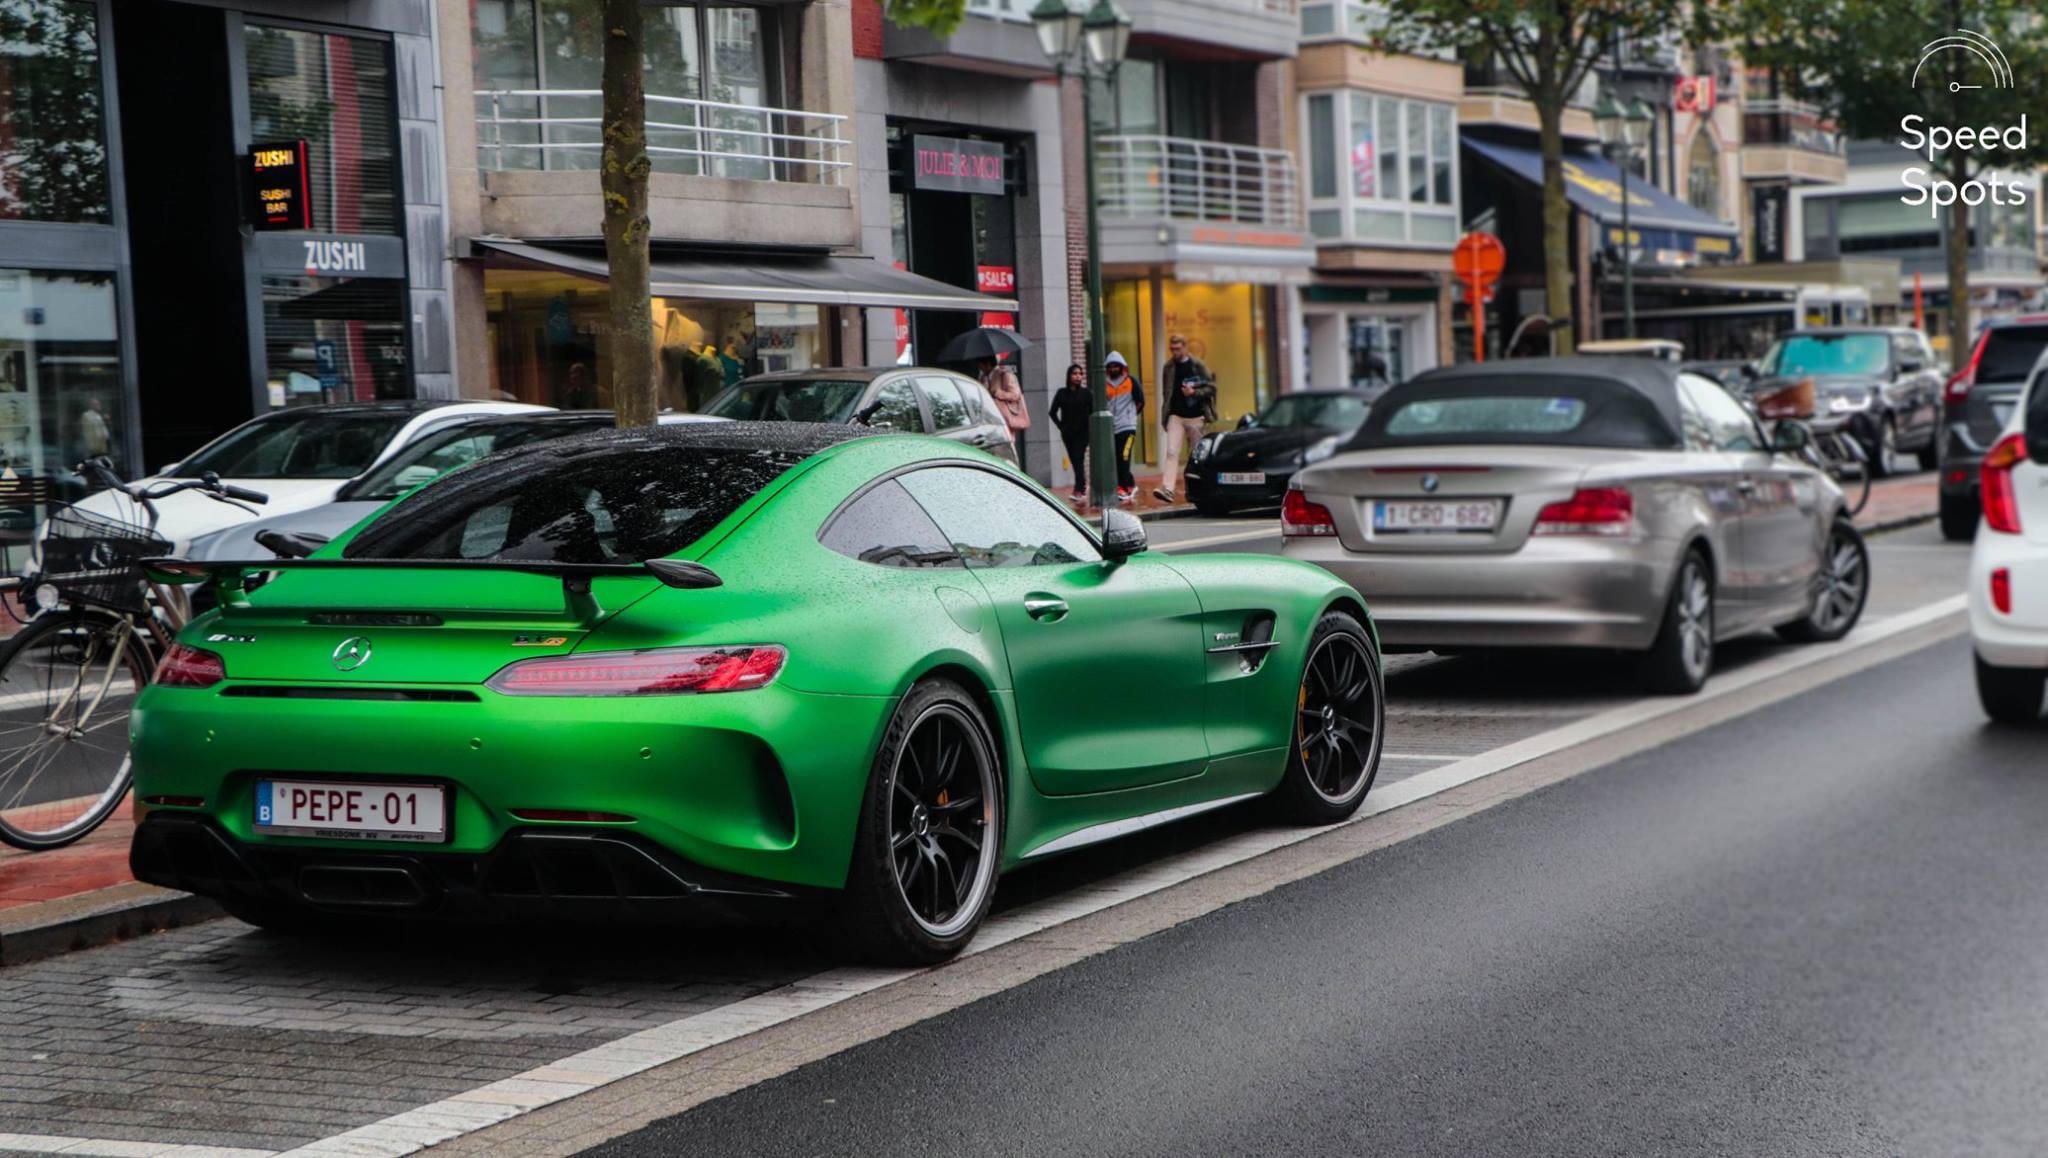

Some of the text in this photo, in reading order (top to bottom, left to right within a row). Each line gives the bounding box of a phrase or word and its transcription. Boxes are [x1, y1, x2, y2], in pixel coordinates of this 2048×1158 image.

[253, 150, 294, 167] ZUSHI
[917, 149, 1001, 180] JULIE & MOI
[260, 188, 292, 201] SUSHI
[266, 202, 288, 213] BAR
[303, 241, 366, 271] ZUSHI
[985, 271, 1008, 284] SALE
[259, 805, 271, 821] B
[292, 788, 417, 825] PEPE-01
